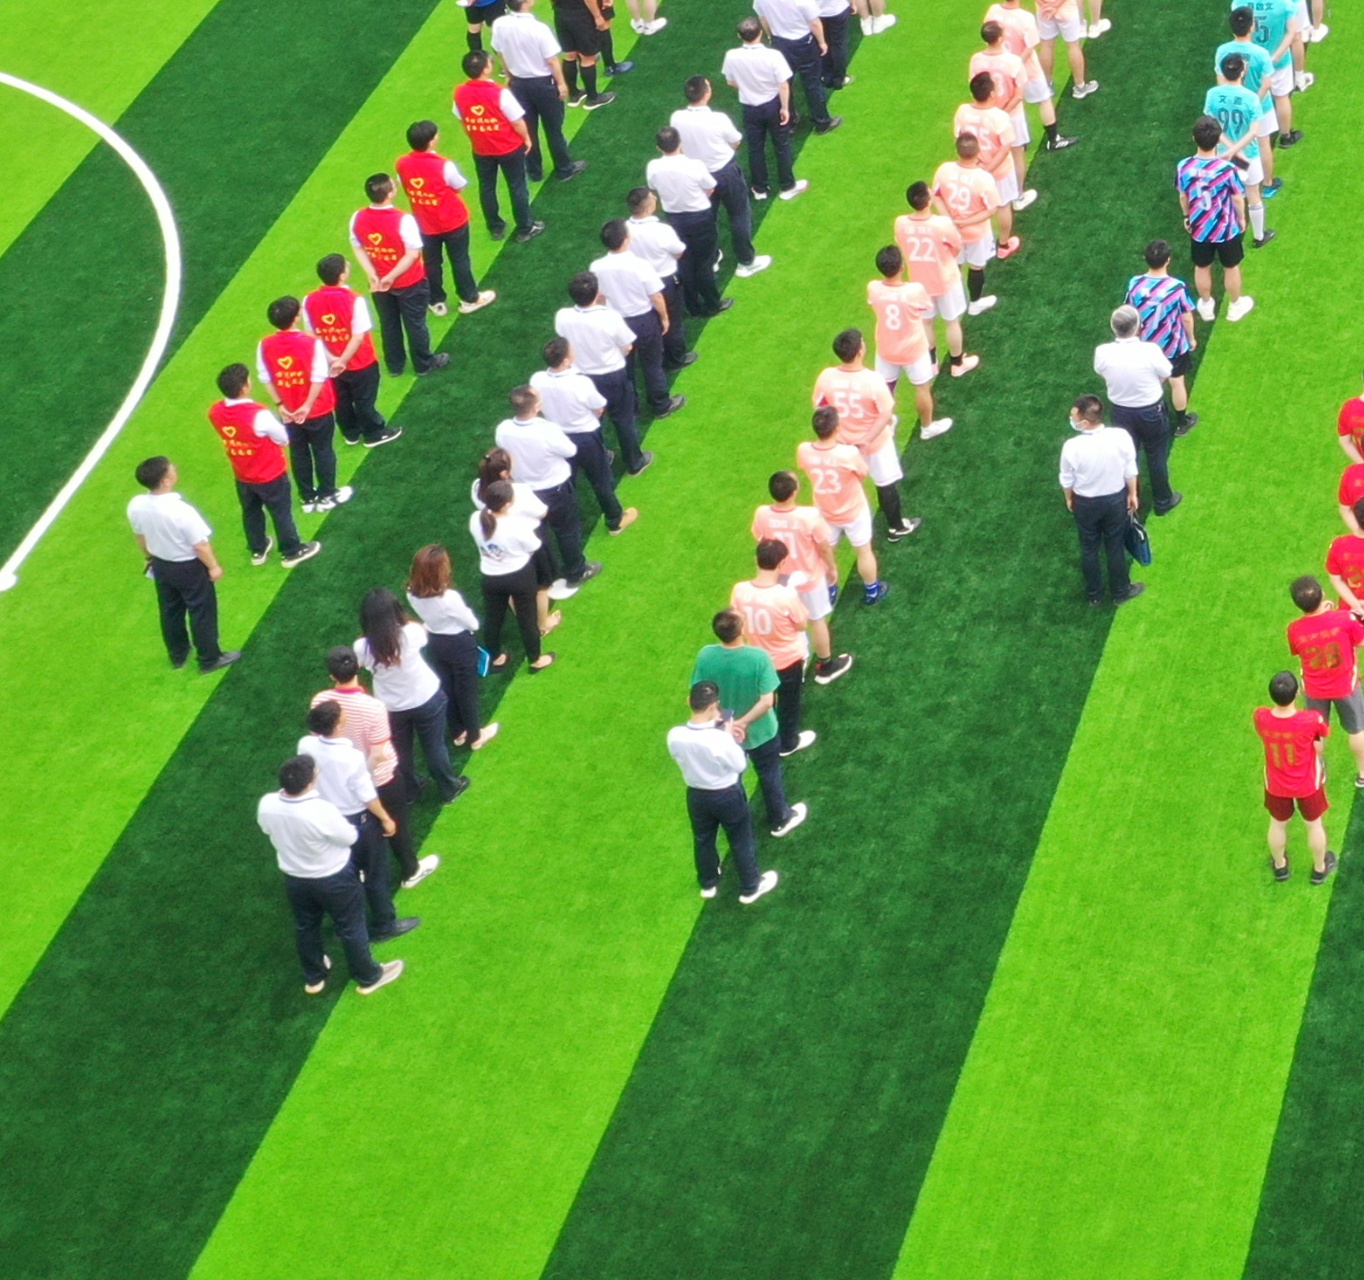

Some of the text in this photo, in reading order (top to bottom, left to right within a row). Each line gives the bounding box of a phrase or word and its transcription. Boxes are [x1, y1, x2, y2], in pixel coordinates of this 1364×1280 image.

[1217, 107, 1243, 136] 99
[947, 182, 973, 212] 29
[907, 237, 937, 263] 22
[885, 303, 902, 331] 8
[833, 391, 865, 419] 55
[810, 468, 843, 495] 23
[744, 605, 772, 635] 10
